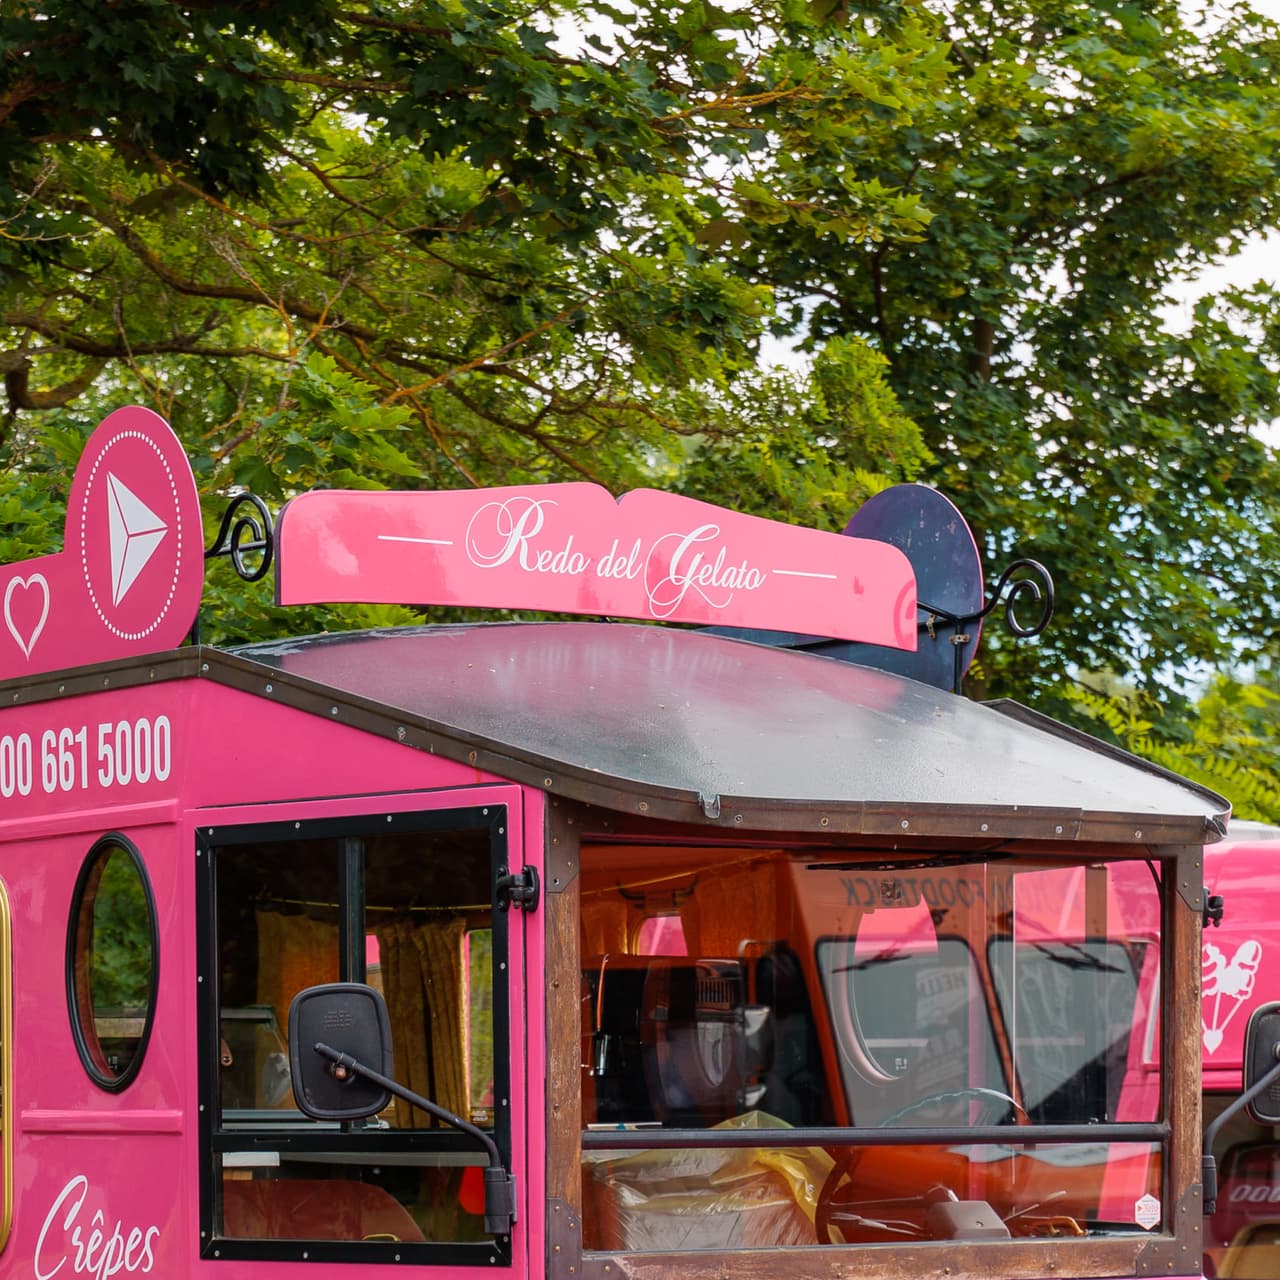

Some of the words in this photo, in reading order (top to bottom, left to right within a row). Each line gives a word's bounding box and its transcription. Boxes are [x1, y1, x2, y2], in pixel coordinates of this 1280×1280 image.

[465, 496, 591, 573] Redo
[597, 537, 642, 579] del
[643, 523, 767, 617] Gelato
[41, 725, 89, 794] 661
[98, 715, 171, 788] 5000
